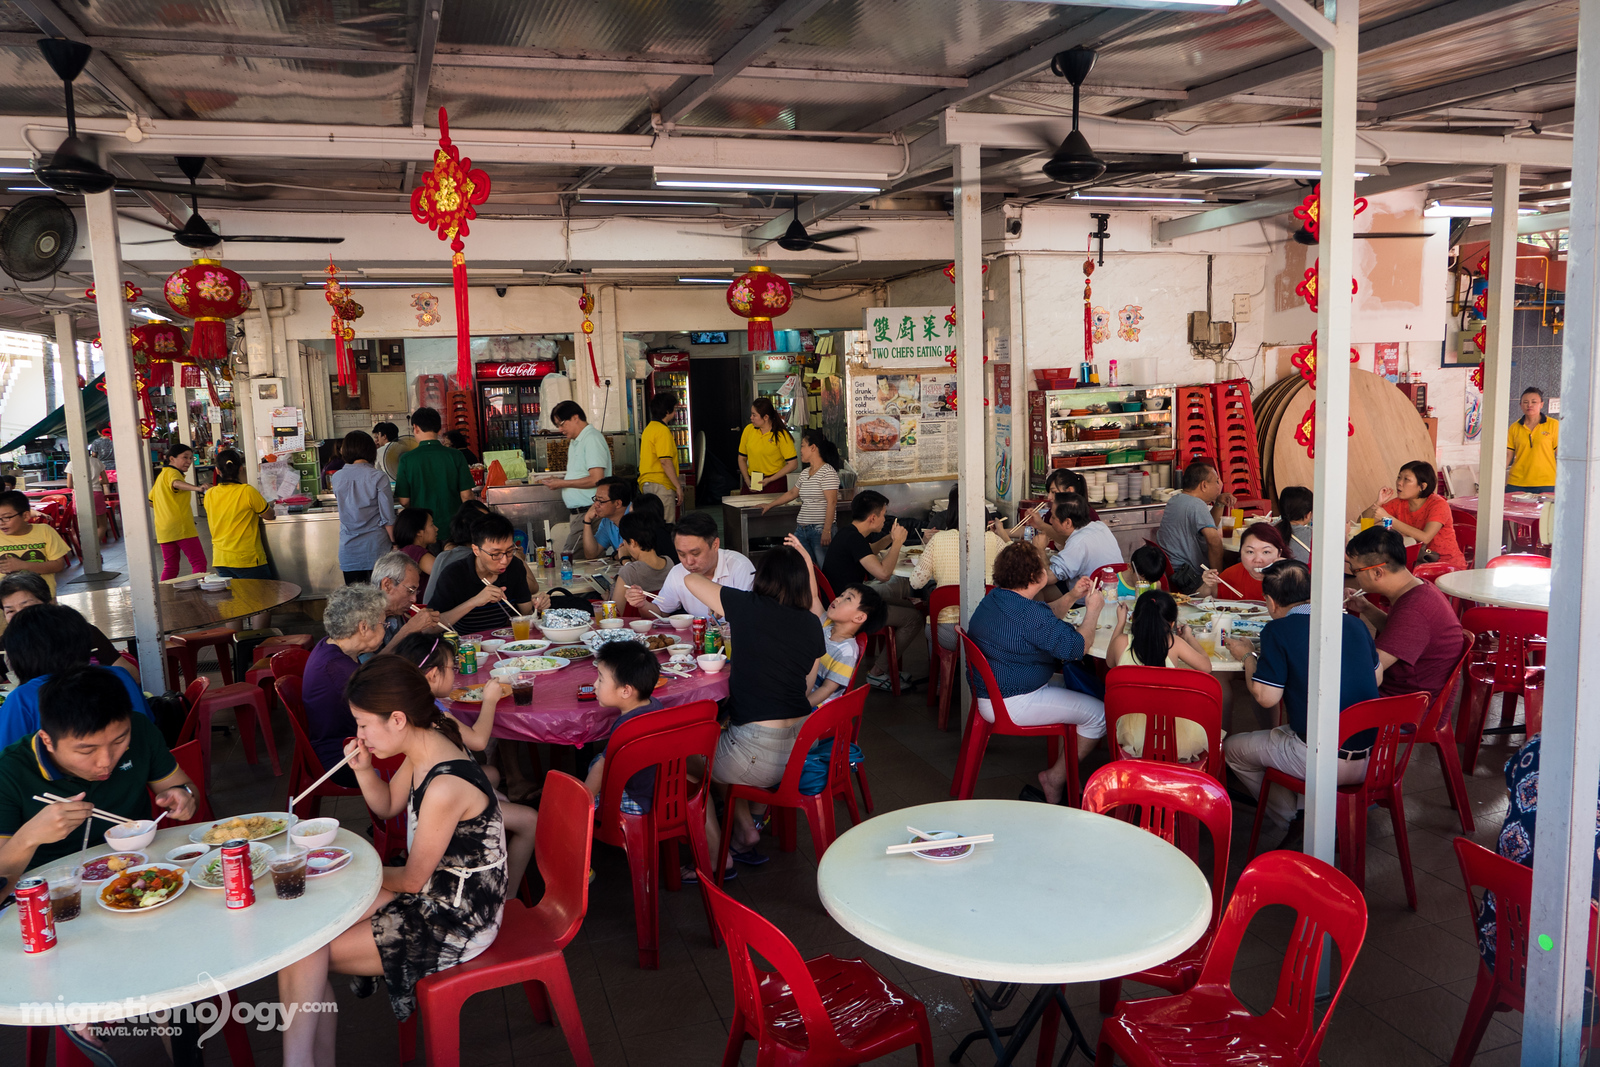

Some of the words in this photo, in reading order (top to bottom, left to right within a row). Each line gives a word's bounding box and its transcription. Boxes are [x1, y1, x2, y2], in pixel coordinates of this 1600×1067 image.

[872, 347, 889, 359] TWO
[891, 346, 914, 358] CHEFS
[917, 345, 942, 358] EATING
[496, 362, 538, 377] Coca-Cola
